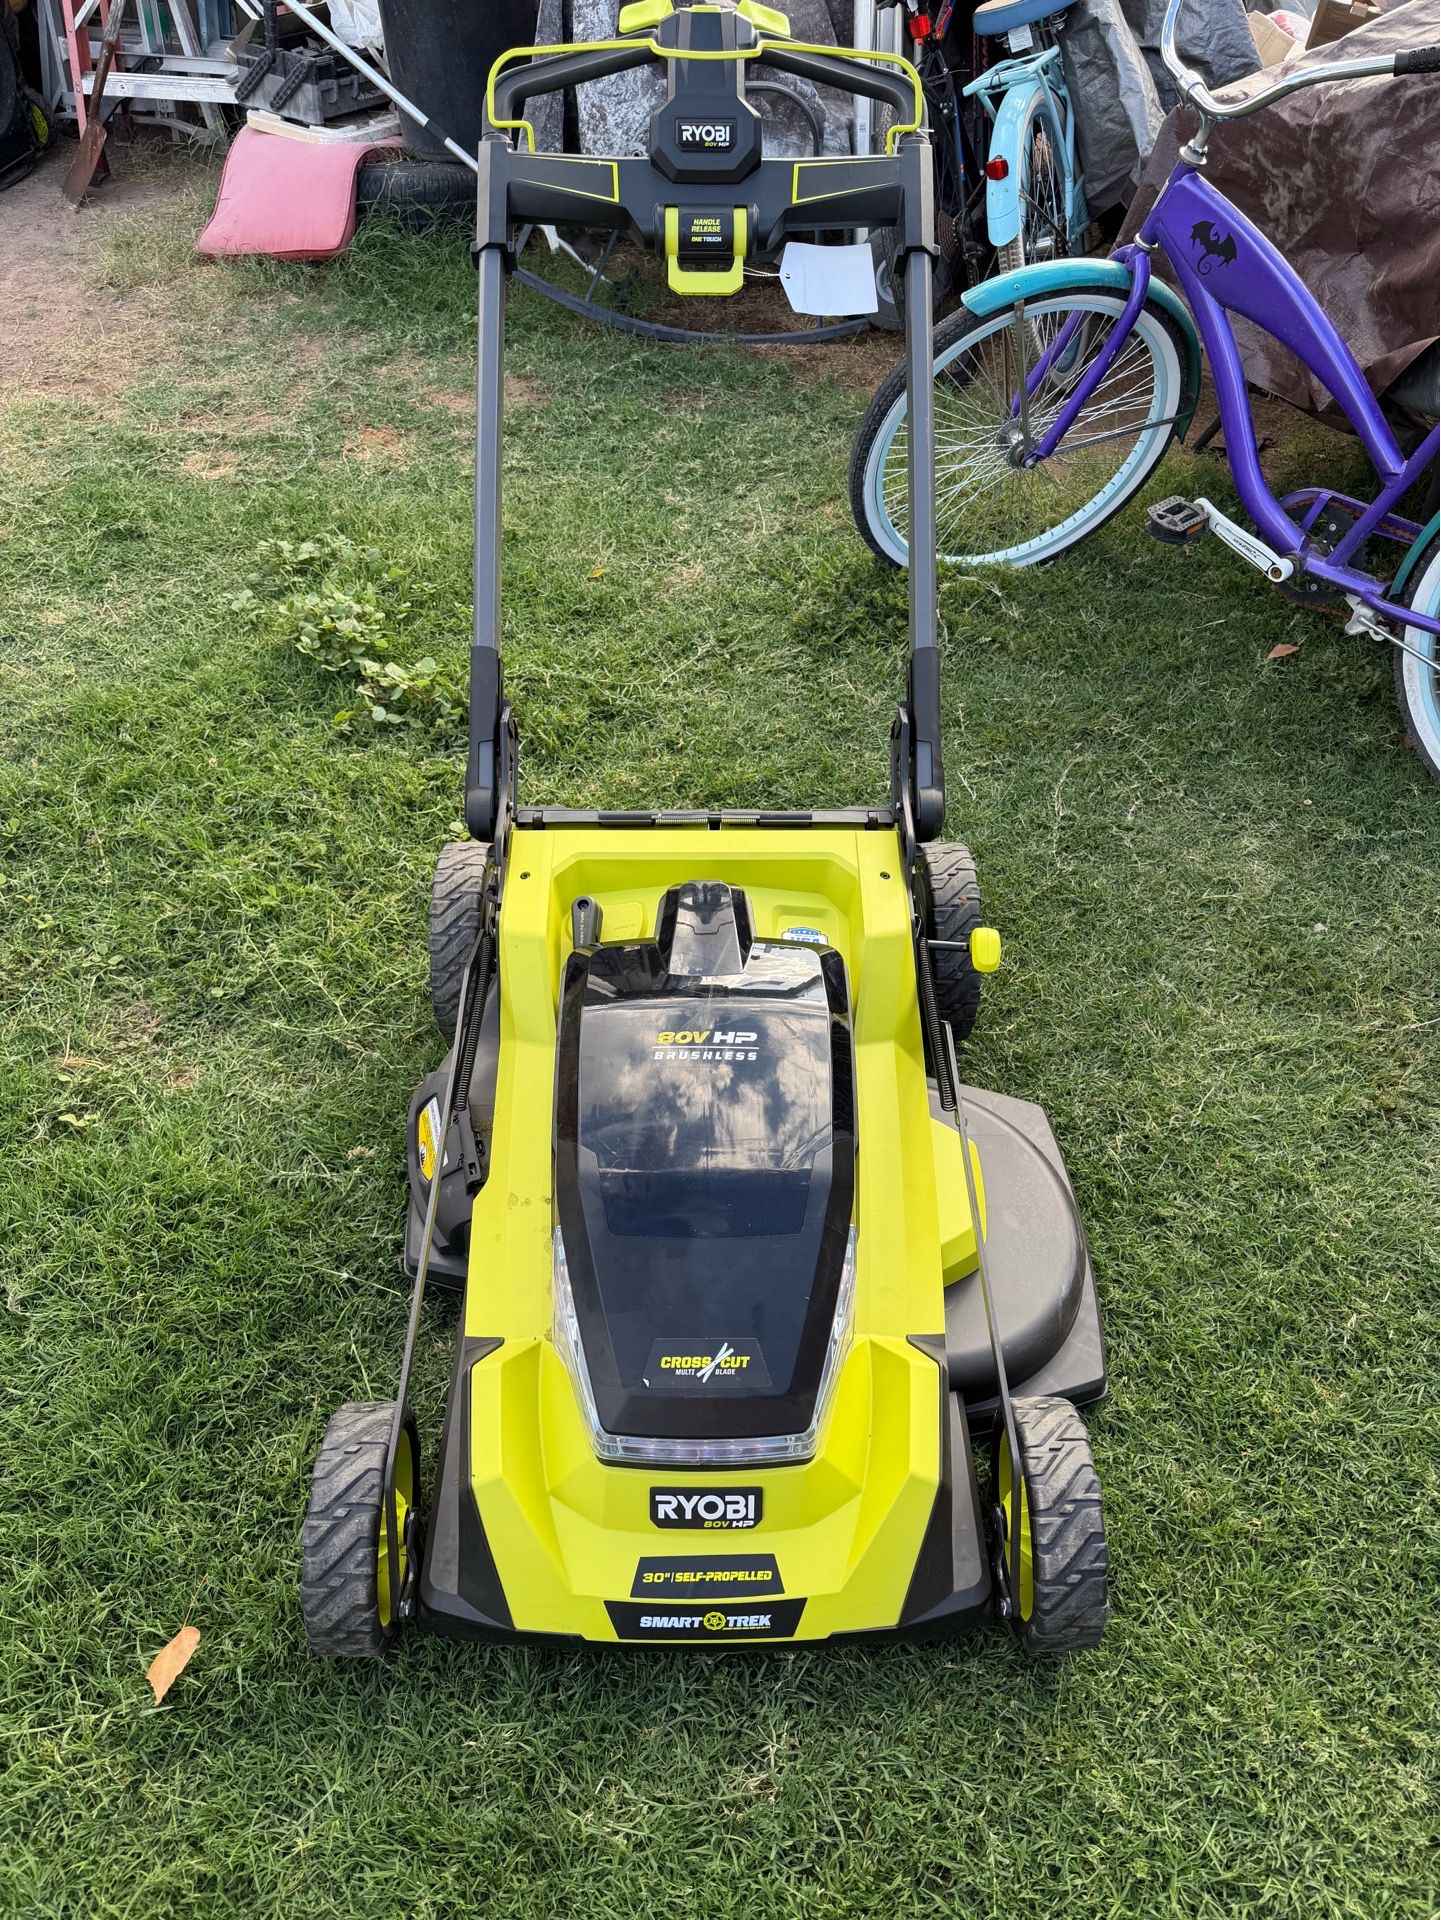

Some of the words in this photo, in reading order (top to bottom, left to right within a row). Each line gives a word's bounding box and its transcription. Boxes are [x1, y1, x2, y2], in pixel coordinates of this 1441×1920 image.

[681, 125, 730, 142] RYOBI
[693, 218, 721, 226] HANDLE
[691, 225, 721, 233] RELEASE
[656, 1030, 711, 1044] 80V
[712, 1031, 758, 1044] HP
[654, 1051, 757, 1061] BRUSHLESS
[660, 1356, 712, 1369] CROSS
[720, 1356, 751, 1368] CUT
[675, 1368, 695, 1376] MULTI
[715, 1368, 736, 1376] BLADE
[655, 1494, 755, 1520] RYOBI
[703, 1520, 730, 1528] 80V
[731, 1520, 755, 1528] HP
[642, 1572, 671, 1584] 30"
[674, 1570, 773, 1583] SELF-PROPELLED
[639, 1615, 703, 1628] SMART
[726, 1614, 772, 1628] TREK
